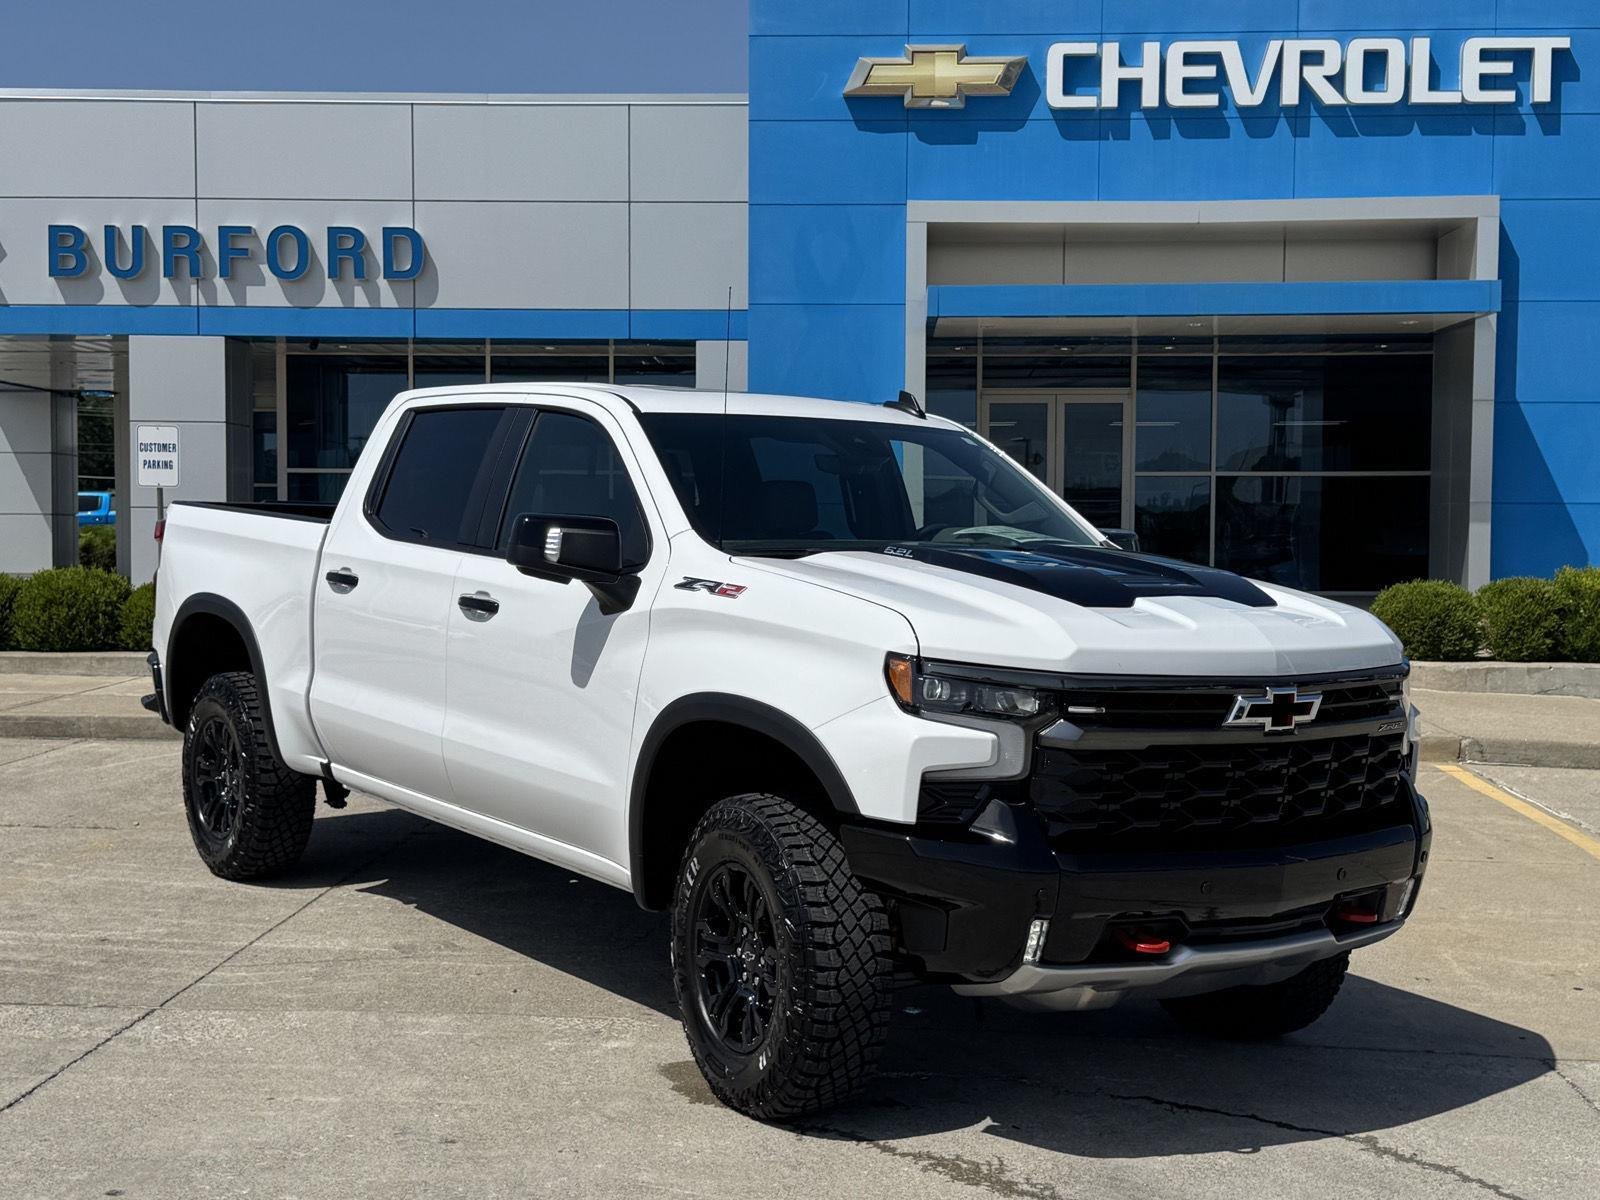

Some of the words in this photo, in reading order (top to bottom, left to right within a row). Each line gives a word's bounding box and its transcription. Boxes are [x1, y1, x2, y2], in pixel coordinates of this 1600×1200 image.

[1045, 36, 1571, 109] CHEVROLET
[48, 224, 426, 282] BURFORD
[139, 442, 177, 453] CUSTOMER
[143, 459, 174, 470] PARKING
[673, 576, 749, 599] ZR2
